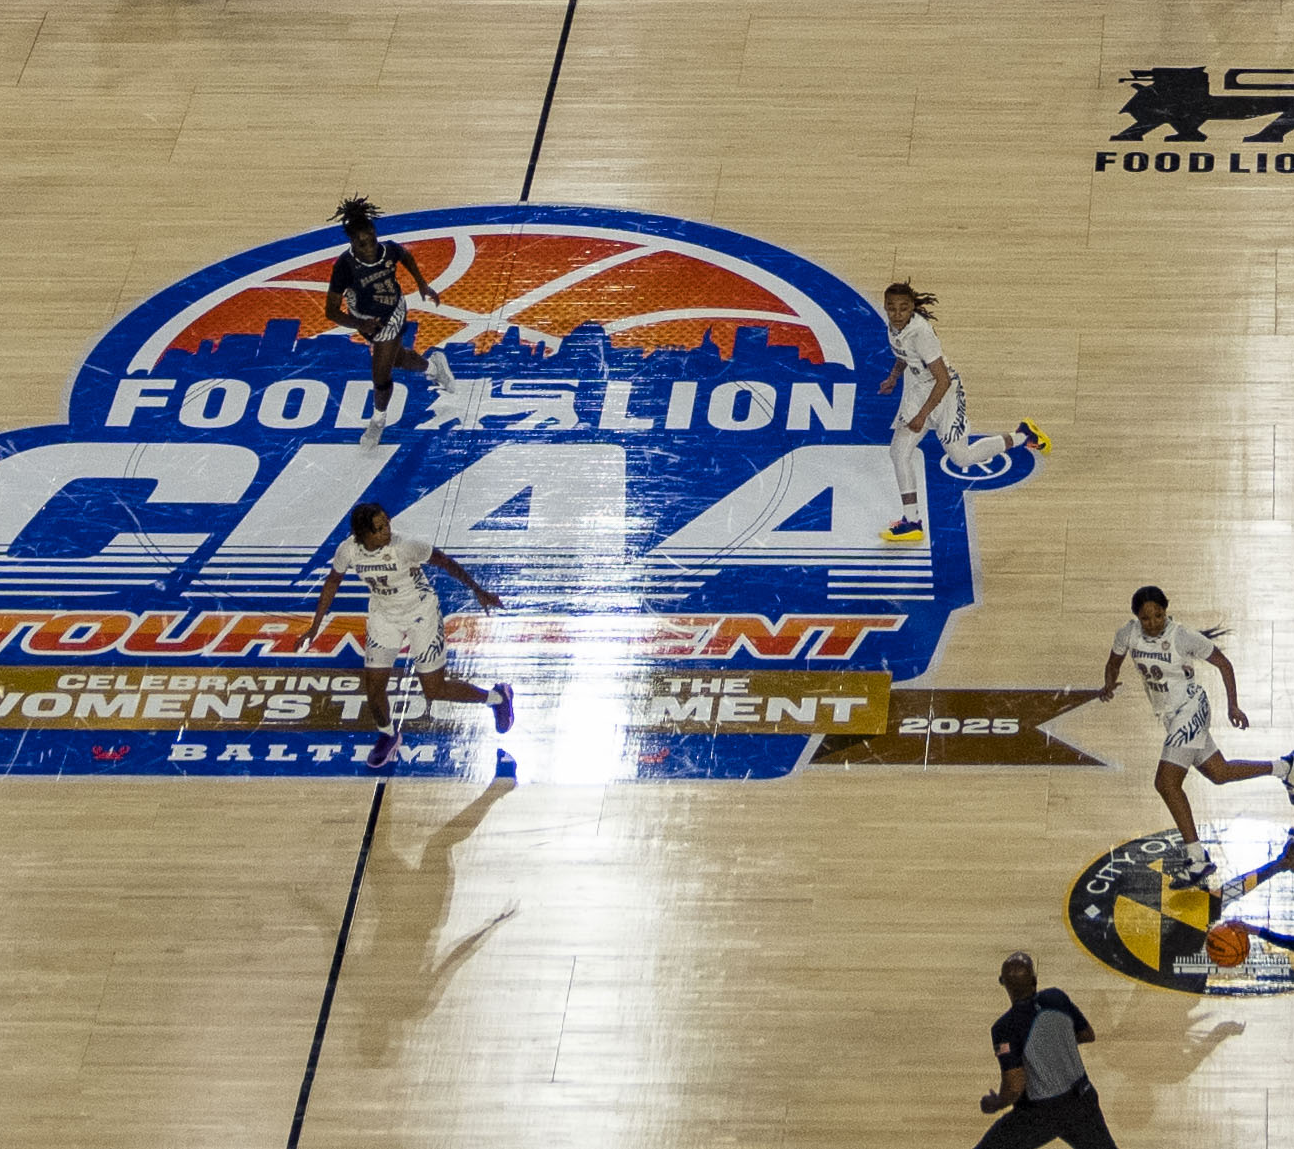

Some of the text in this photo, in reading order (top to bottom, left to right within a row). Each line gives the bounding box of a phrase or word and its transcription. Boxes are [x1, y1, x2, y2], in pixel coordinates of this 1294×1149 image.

[1095, 151, 1215, 173] FOOD
[105, 377, 856, 431] FOOD LION
[56, 674, 361, 692] CELEBRATING
[666, 677, 751, 694] THE
[898, 717, 1020, 735] 2025
[1086, 849, 1136, 894] CITY
